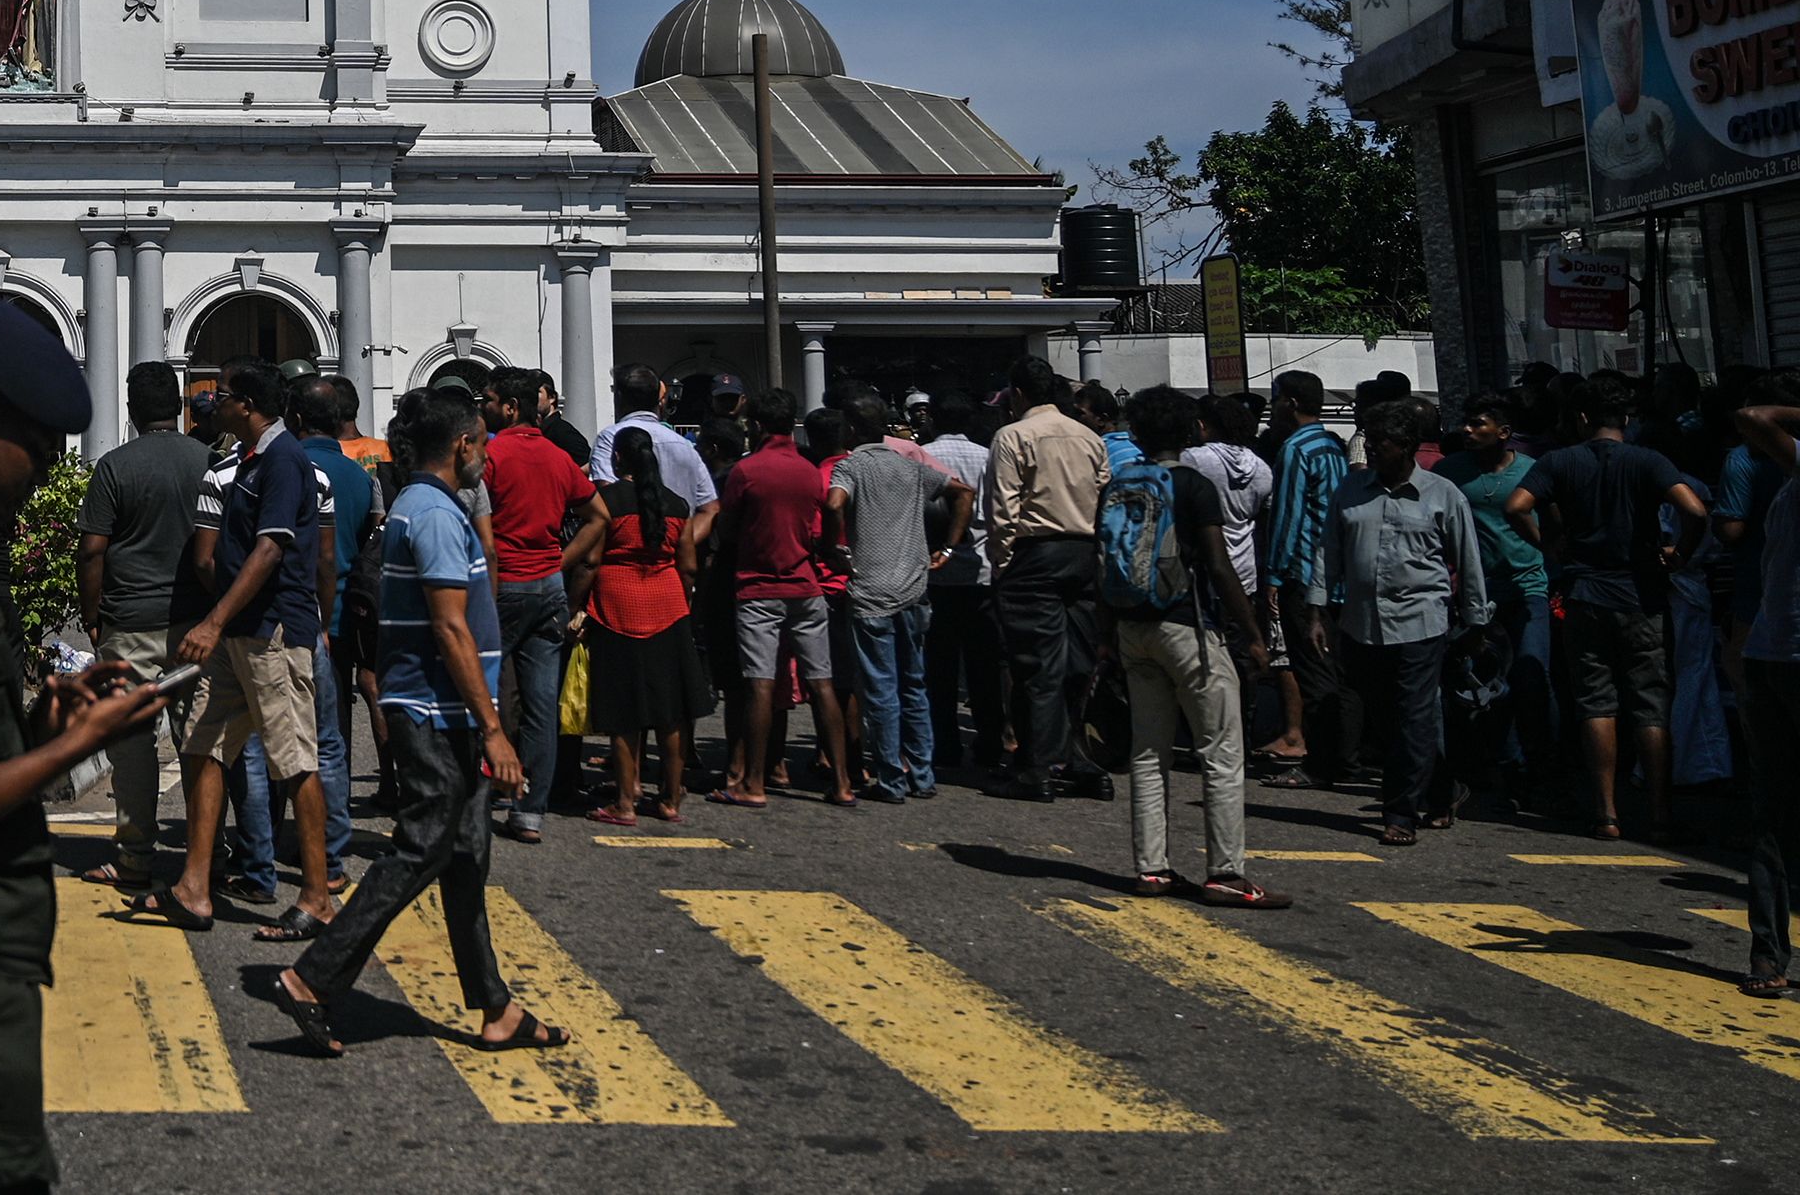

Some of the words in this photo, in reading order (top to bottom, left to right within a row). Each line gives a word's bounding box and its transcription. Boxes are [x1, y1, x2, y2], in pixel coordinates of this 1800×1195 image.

[1690, 21, 1800, 103] SWE
[1728, 99, 1800, 144] CHOI
[1616, 185, 1671, 211] Jampettah
[1672, 178, 1708, 197] Street,
[1710, 161, 1780, 189] Colombo-13.
[1574, 260, 1620, 276] Dialog
